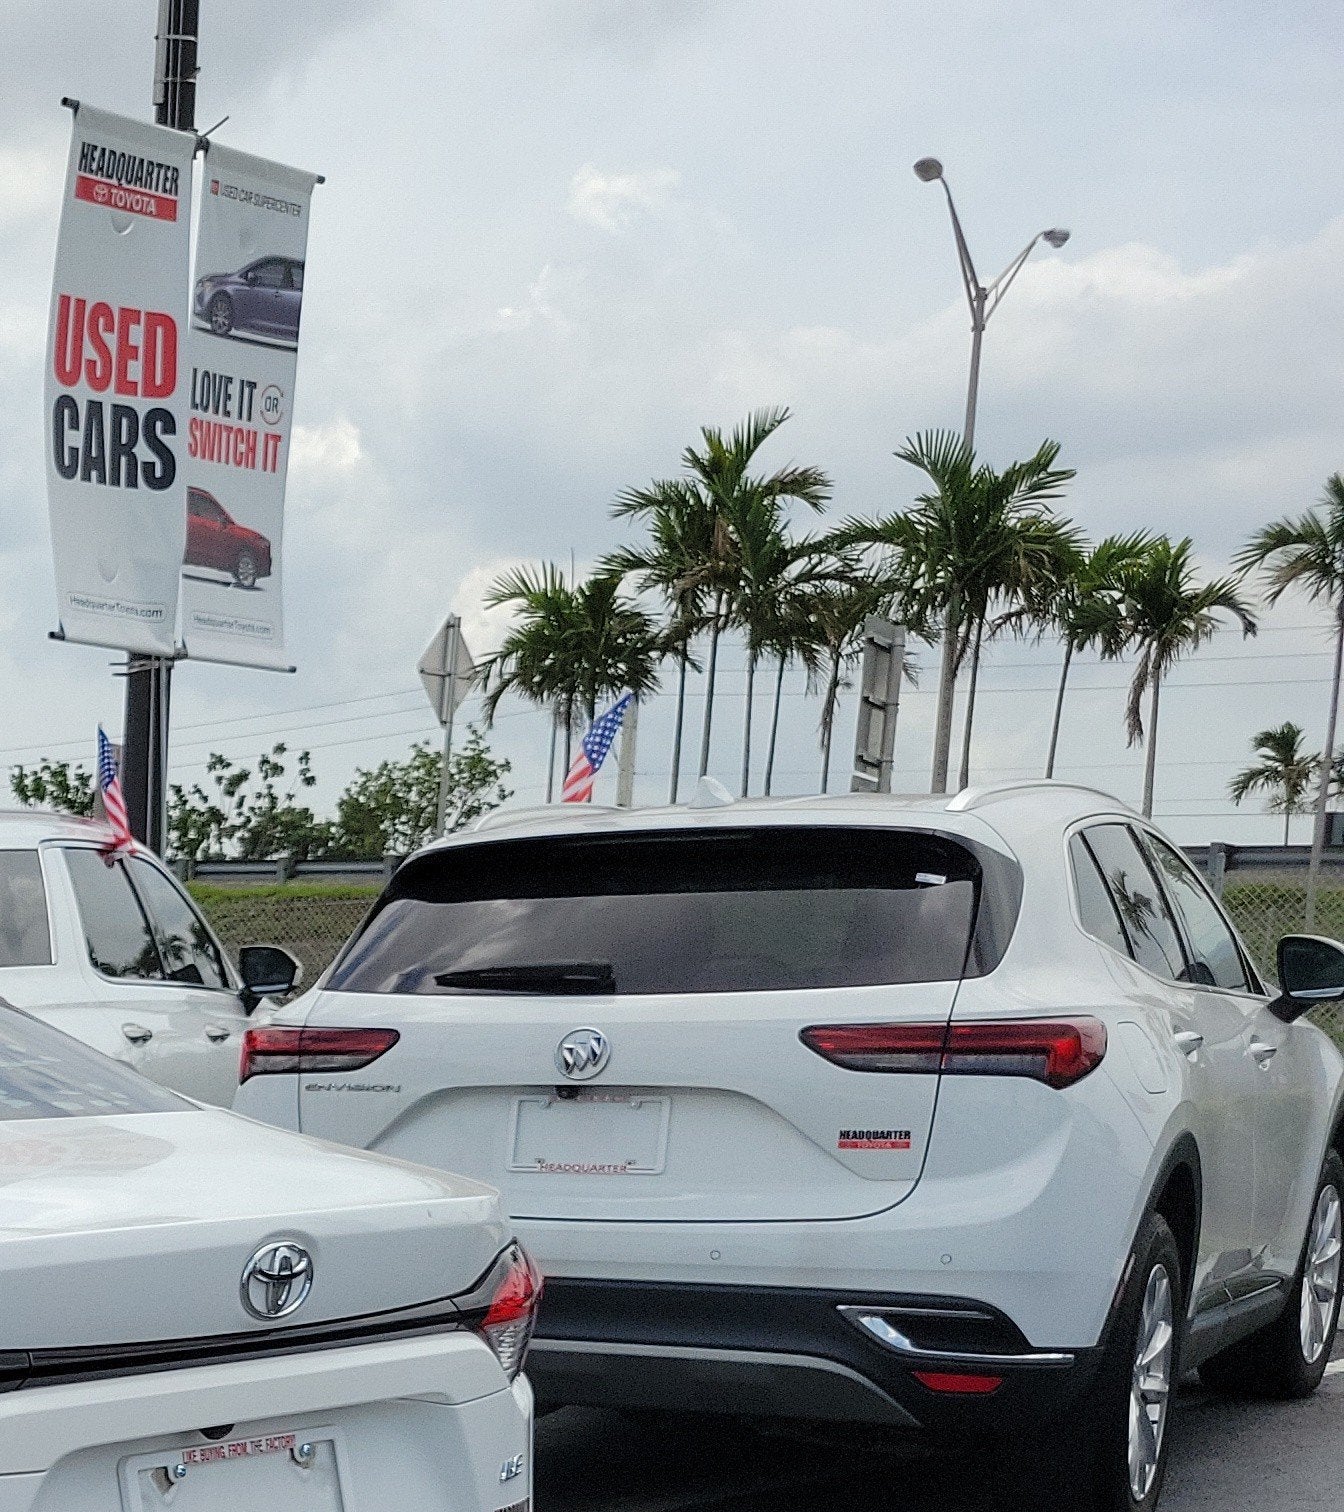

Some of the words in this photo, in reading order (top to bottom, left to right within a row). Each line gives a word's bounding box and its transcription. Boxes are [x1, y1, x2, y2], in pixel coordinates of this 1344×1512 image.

[77, 141, 180, 197] HEADQUARTER
[110, 188, 157, 216] TOYOTA
[53, 293, 179, 399] USED
[190, 367, 233, 418] LOVE
[237, 378, 258, 423] IT
[264, 395, 279, 414] OR
[52, 394, 177, 492] CARS
[187, 416, 258, 470] SWITCH
[261, 432, 282, 474] IT
[839, 1129, 912, 1142] HEADQUARTER
[538, 1162, 628, 1174] HEADQUARTER
